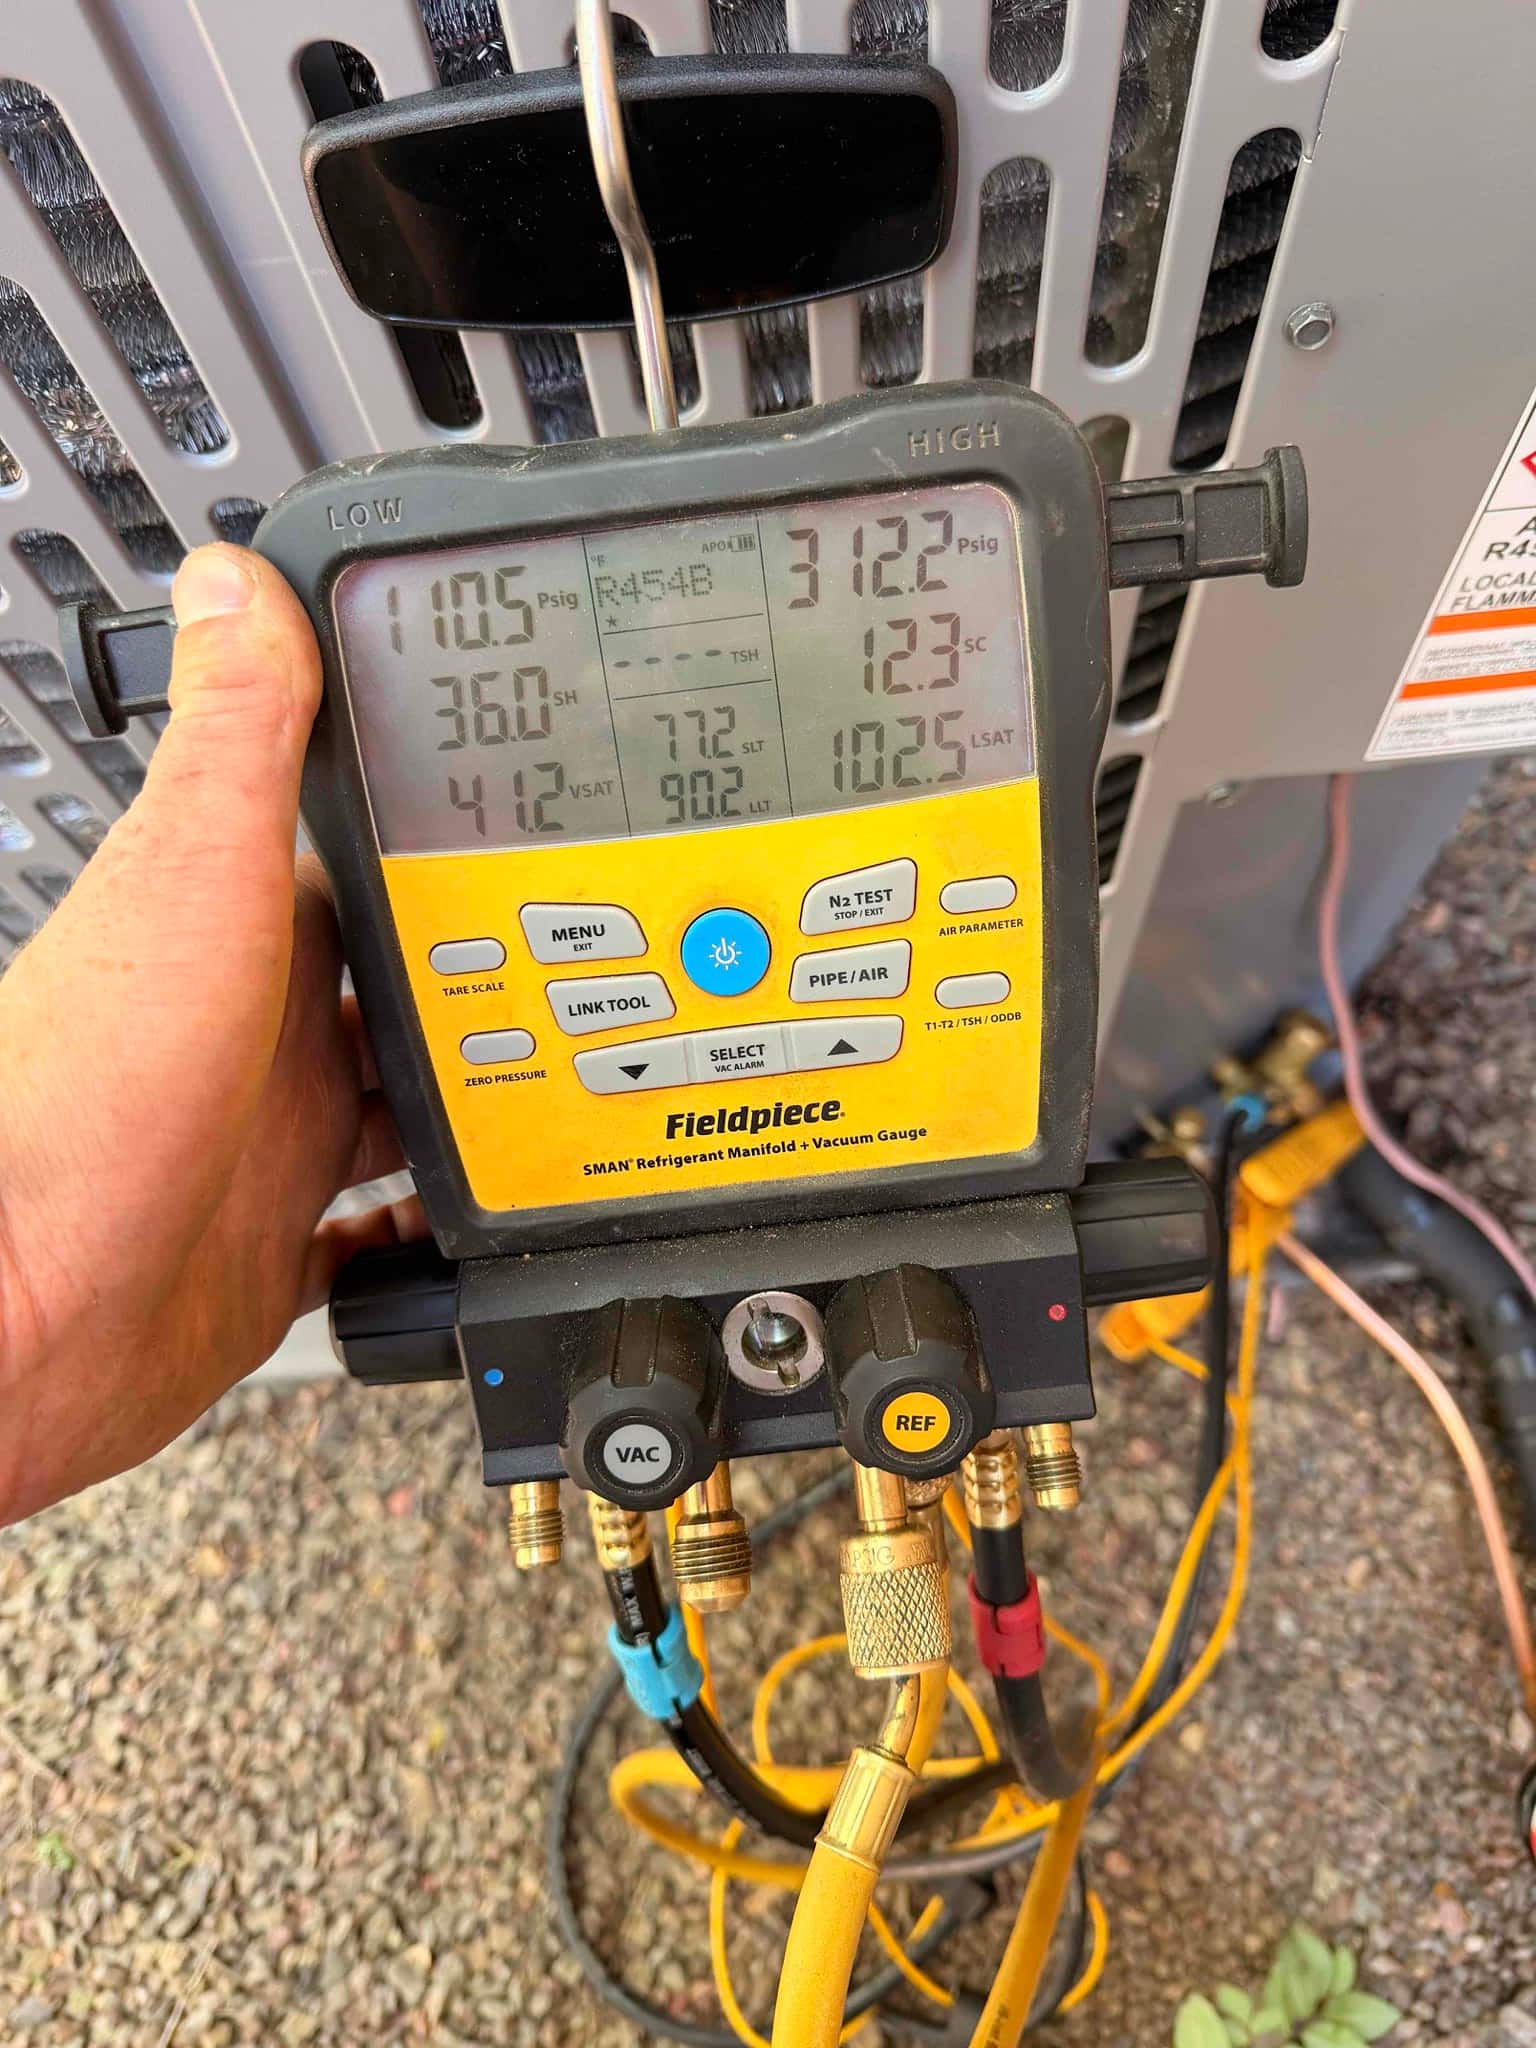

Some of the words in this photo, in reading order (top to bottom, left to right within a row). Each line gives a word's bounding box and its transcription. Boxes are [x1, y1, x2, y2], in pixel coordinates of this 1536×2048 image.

[907, 420, 1001, 457] HIGH
[327, 497, 403, 531] LOW
[786, 510, 953, 610] 312.2
[957, 535, 999, 555] Psig
[594, 563, 713, 608] R454B
[386, 565, 534, 655] 110.5
[537, 590, 579, 610] Psig
[730, 648, 760, 664] TSH
[863, 612, 961, 695] 12.3
[964, 637, 987, 653] SC
[430, 665, 552, 751] 36.0
[553, 689, 579, 706] SH
[653, 705, 736, 762] 77.2
[742, 740, 765, 754] SLT
[833, 710, 966, 793] 102.5
[971, 729, 1015, 749] LSAT
[448, 761, 565, 837] 41.2
[568, 780, 614, 799] VSAT
[660, 766, 744, 824] 90.2
[749, 800, 770, 813] LLT
[829, 894, 851, 909] N2
[854, 889, 893, 906] TEST
[834, 909, 858, 920] STOP
[864, 907, 884, 918] EXIT
[552, 923, 606, 942] MENU
[938, 925, 957, 937] AIR
[959, 918, 1024, 935] PARAMETER
[573, 942, 593, 952] EXIT
[442, 985, 470, 997] TARE
[471, 981, 505, 993] SCALE
[568, 1001, 605, 1017] LINK
[607, 996, 651, 1011] TOOL
[924, 1020, 954, 1031] T1-T2
[962, 1016, 982, 1027] TSH
[990, 1011, 1022, 1023] ODDB
[710, 1044, 766, 1062] SELECT
[714, 1064, 732, 1074] VAC
[733, 1060, 765, 1072] ALARM
[464, 1075, 493, 1087] ZERO
[495, 1069, 547, 1084] PRESSURE
[665, 1099, 842, 1140] Fieldpiece
[636, 1149, 725, 1171] Refrigerant
[727, 1140, 797, 1160] Manifold
[812, 1133, 874, 1149] Vacuum
[877, 1126, 928, 1144] Gauge
[895, 1415, 936, 1431] REF
[615, 1446, 660, 1463] VAC
